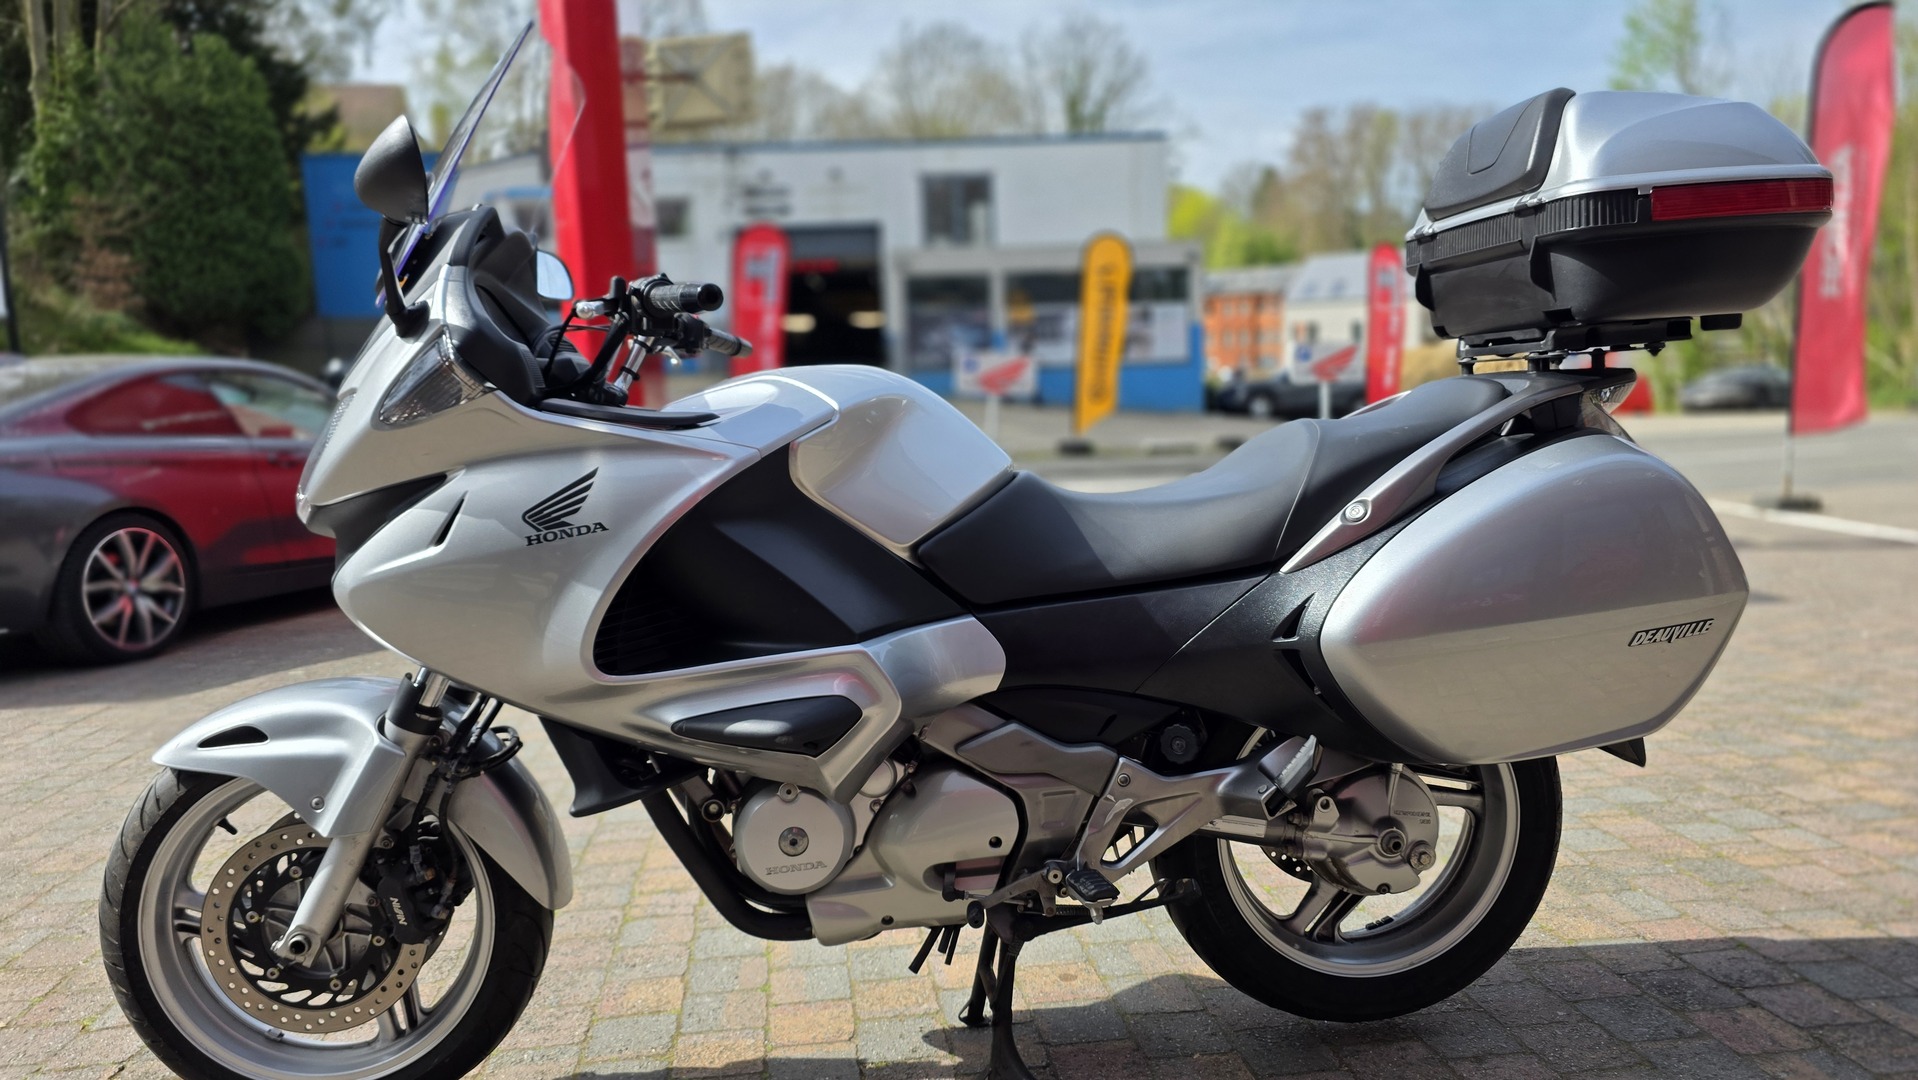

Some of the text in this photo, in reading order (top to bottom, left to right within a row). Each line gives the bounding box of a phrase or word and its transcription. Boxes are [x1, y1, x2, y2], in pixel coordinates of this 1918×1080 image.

[525, 521, 610, 547] HONDA
[1629, 619, 1714, 647] DEAUVILLE
[765, 860, 828, 876] HONDA
